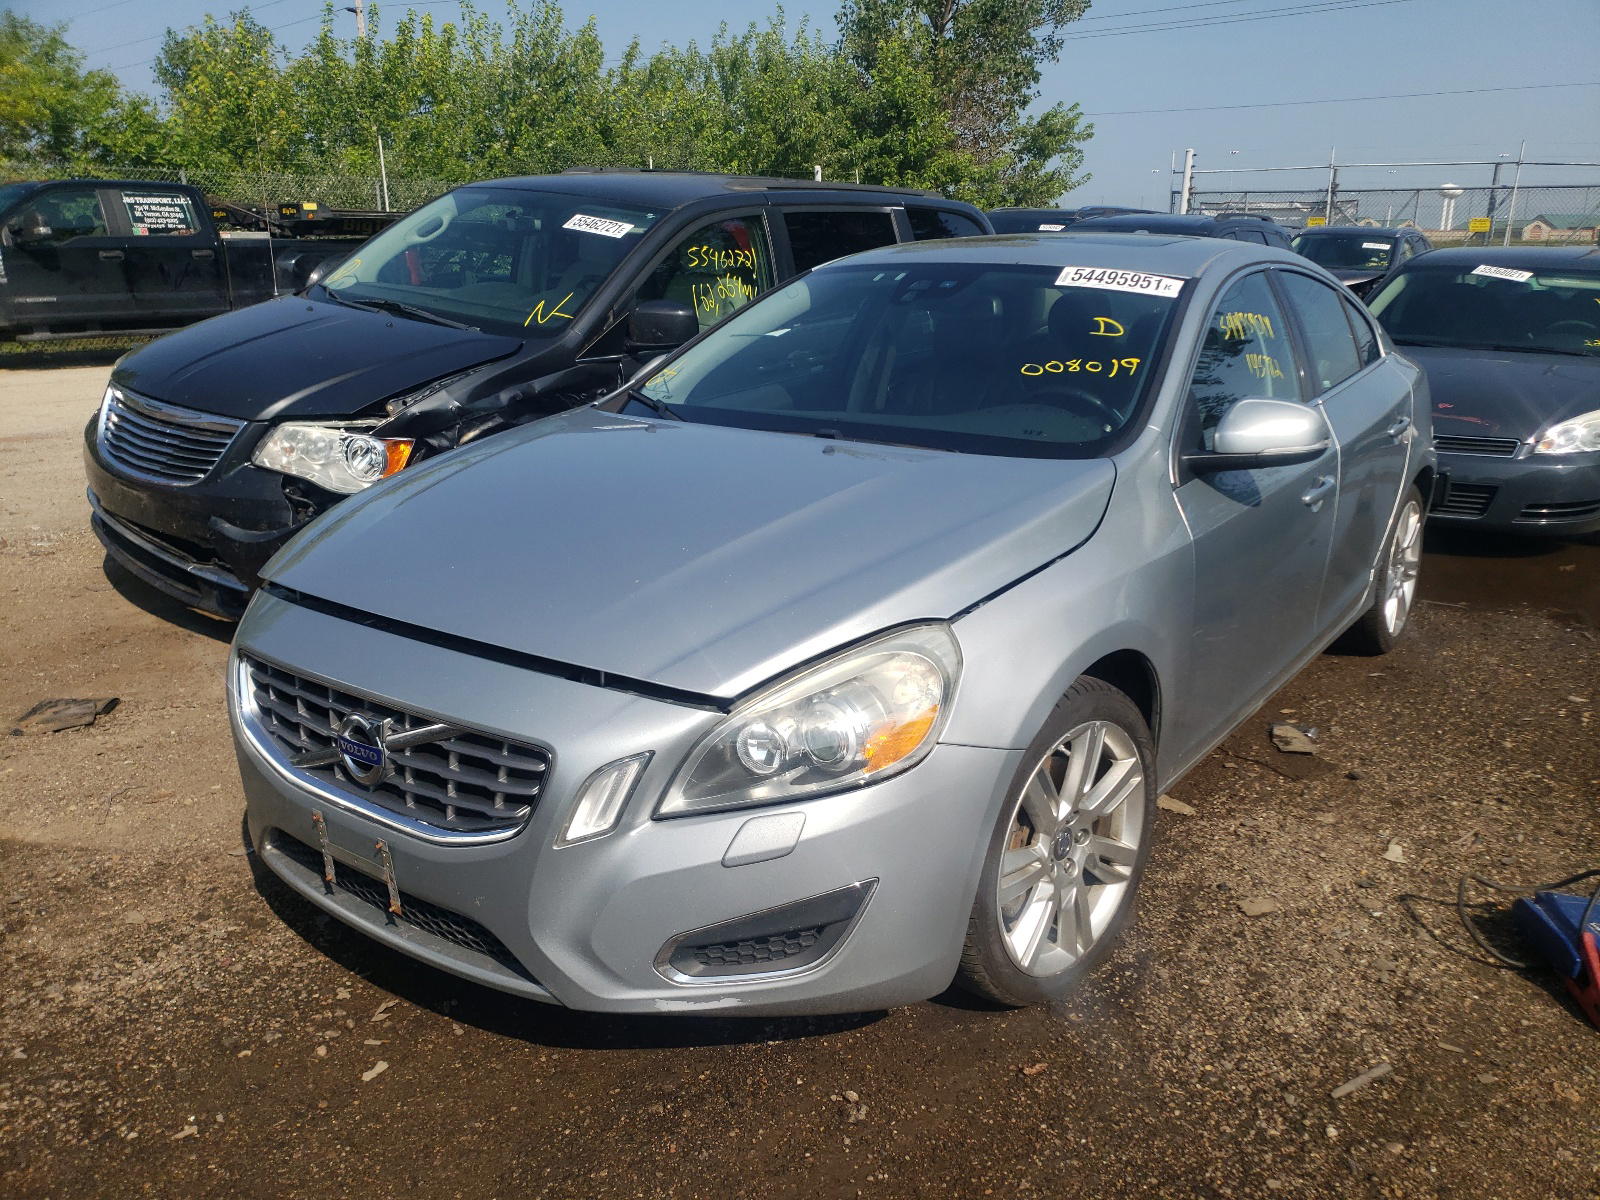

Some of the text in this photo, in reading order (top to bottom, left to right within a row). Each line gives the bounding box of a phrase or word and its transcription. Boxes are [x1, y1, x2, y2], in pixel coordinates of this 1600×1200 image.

[1071, 268, 1162, 291] 54495951
[1088, 316, 1125, 336] D
[1020, 357, 1141, 378] 008019
[340, 740, 378, 761] VOLVO
